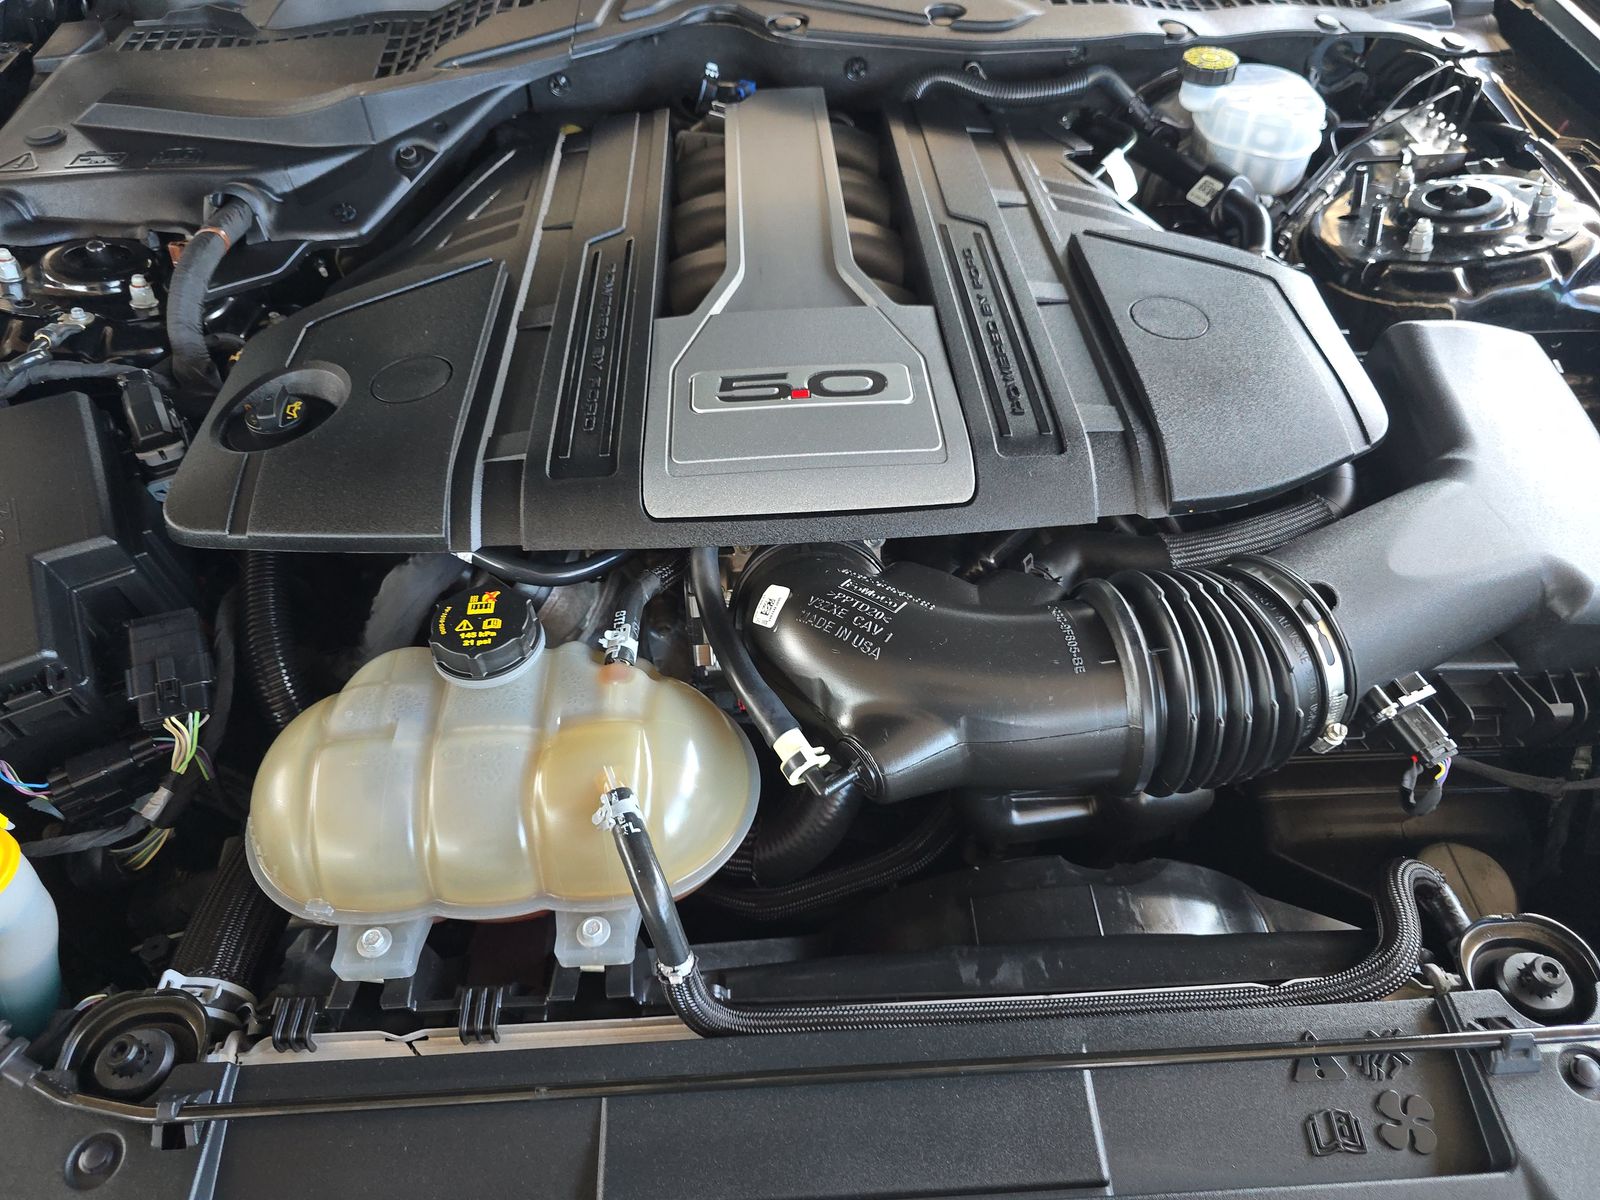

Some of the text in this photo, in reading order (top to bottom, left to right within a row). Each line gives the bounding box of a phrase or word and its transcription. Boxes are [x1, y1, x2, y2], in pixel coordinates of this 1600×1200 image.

[976, 293, 994, 317] BY
[986, 320, 1025, 416] POWERED
[716, 369, 888, 402] 5.0
[852, 615, 884, 636] CAV
[462, 638, 492, 647] 21 psi
[834, 625, 851, 642] IN
[852, 634, 881, 660] USA
